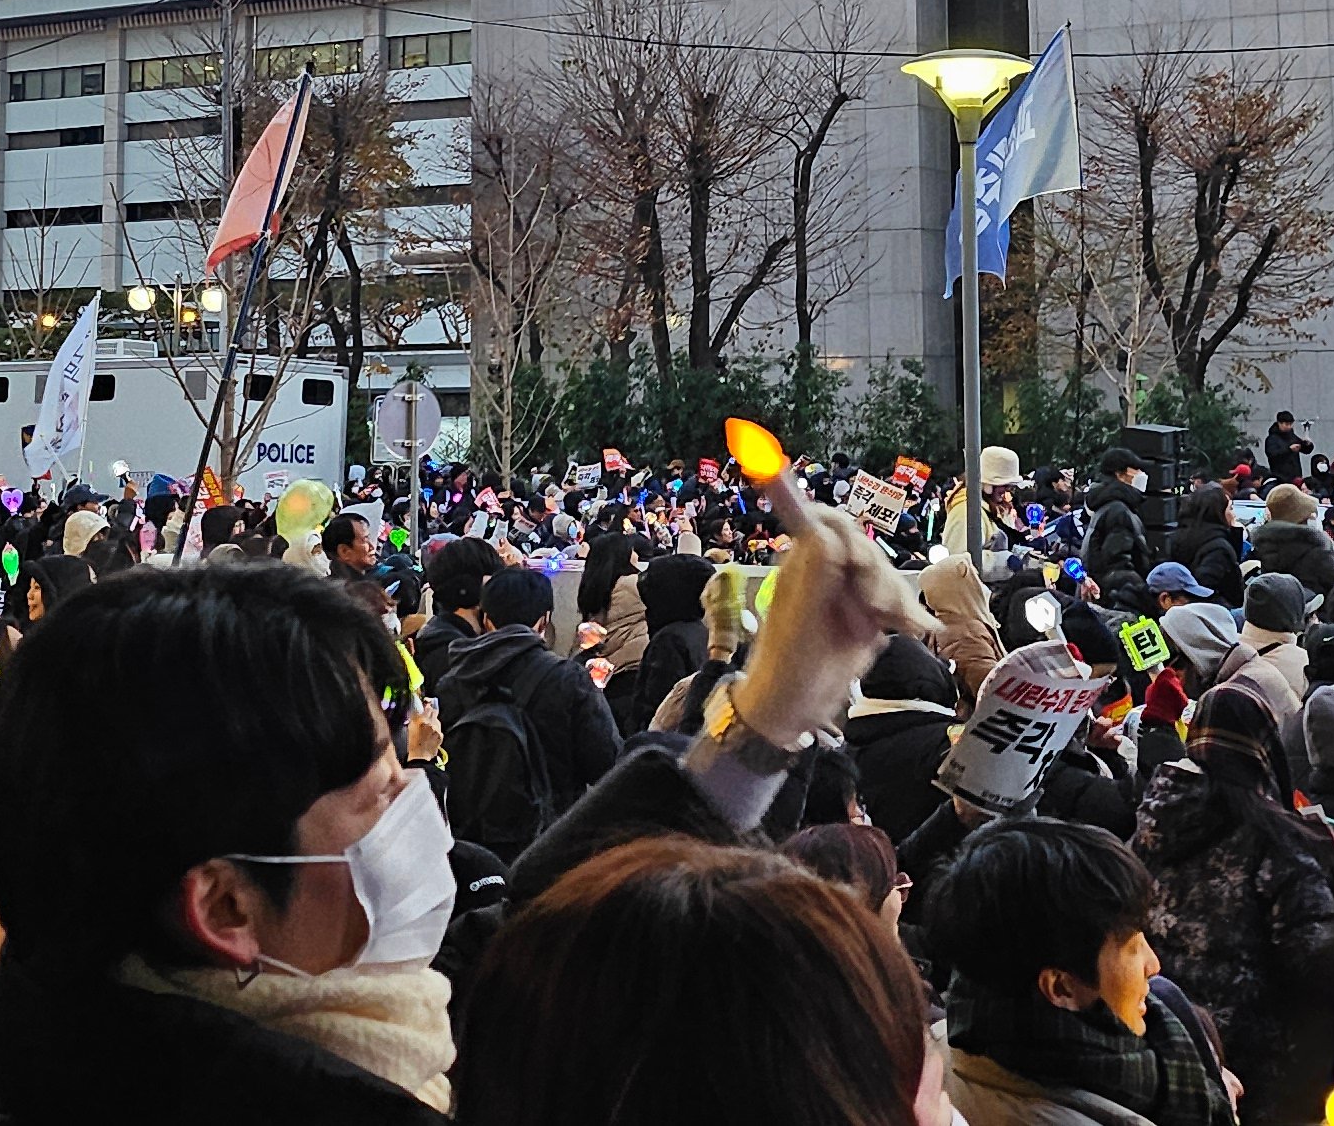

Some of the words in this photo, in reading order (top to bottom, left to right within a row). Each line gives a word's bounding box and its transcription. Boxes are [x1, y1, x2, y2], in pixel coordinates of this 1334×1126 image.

[257, 442, 315, 464] POLICE
[853, 485, 875, 504] 즉각
[865, 503, 899, 525] 체포!
[1132, 628, 1162, 661] 탄
[969, 708, 1058, 765] 즉각
